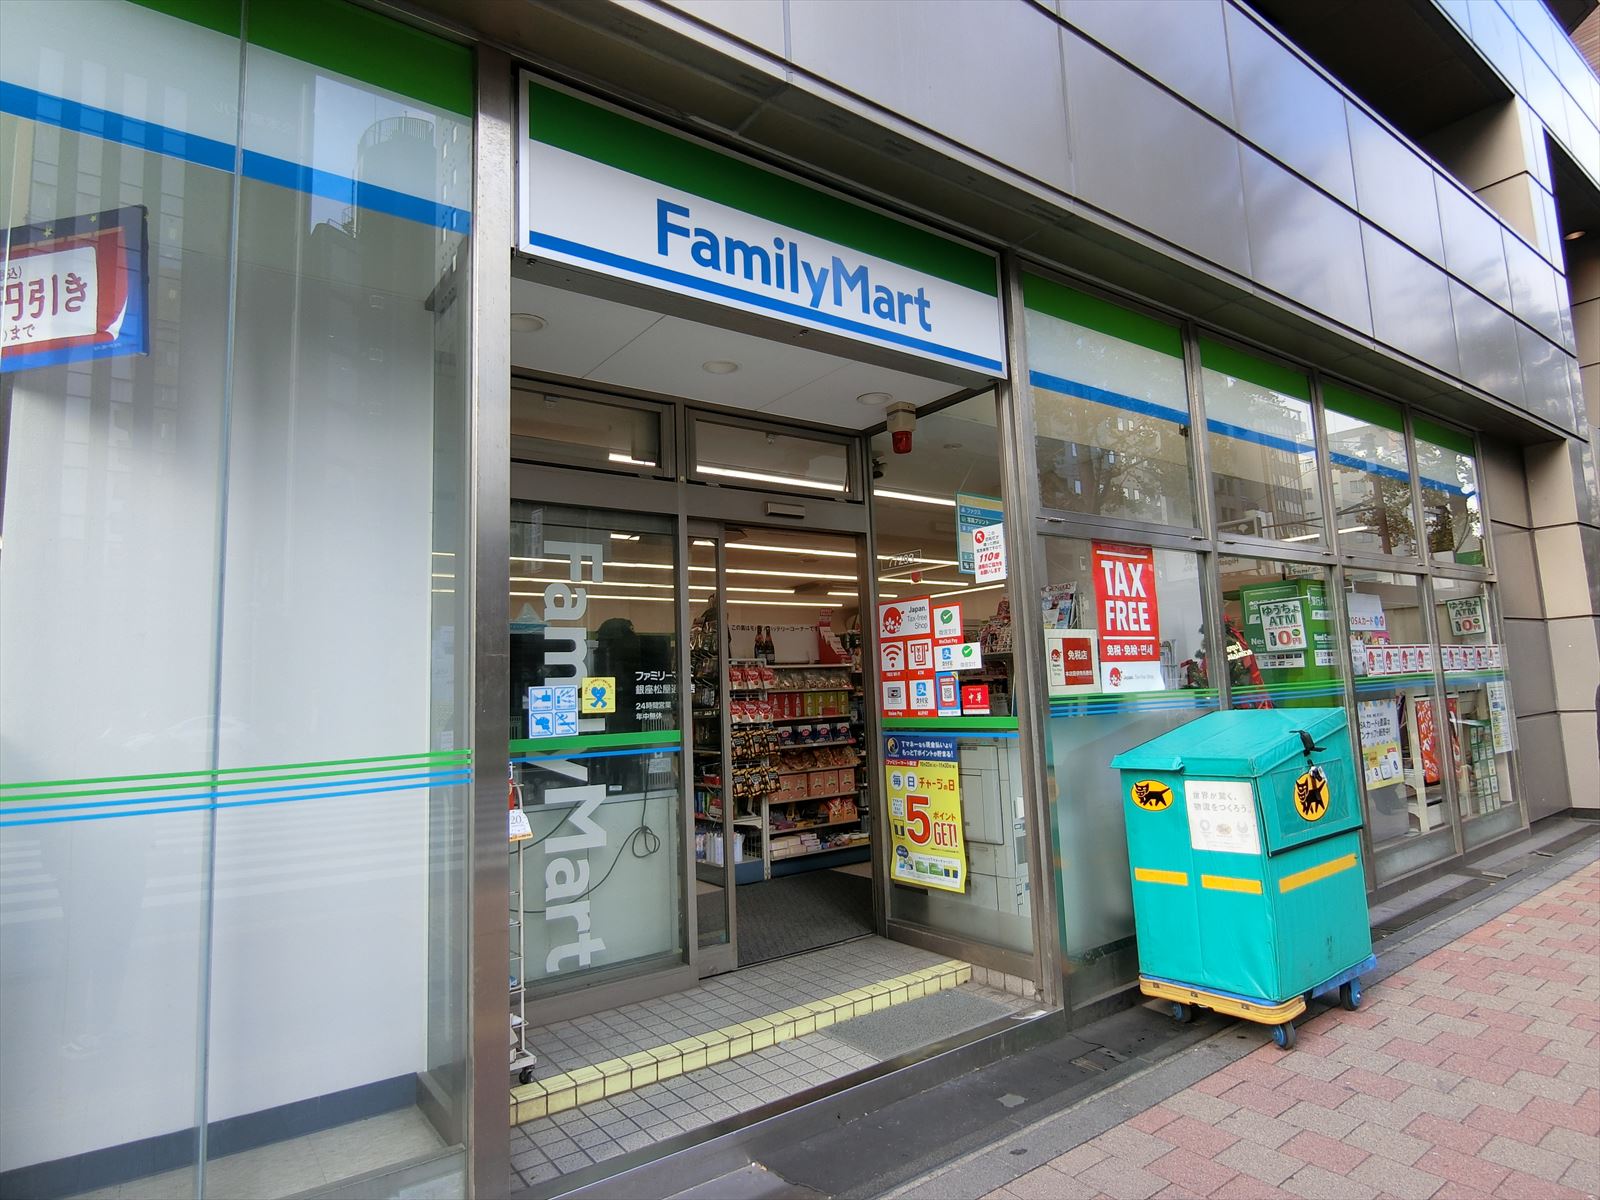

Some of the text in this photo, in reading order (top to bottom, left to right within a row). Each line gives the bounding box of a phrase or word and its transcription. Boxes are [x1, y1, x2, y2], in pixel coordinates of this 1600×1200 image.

[656, 198, 932, 333] FamilyMart
[1101, 560, 1147, 597] TAX
[1105, 600, 1151, 631] FREE
[1262, 603, 1300, 617] ゆうちょ
[1455, 607, 1478, 617] ATM
[914, 622, 928, 630] Shop
[1269, 614, 1297, 627] ATM
[635, 701, 672, 710] 24時間営業
[635, 712, 663, 720] 年中無休
[905, 794, 932, 845] 5
[932, 811, 957, 821] ポイント
[933, 821, 958, 848] GET!
